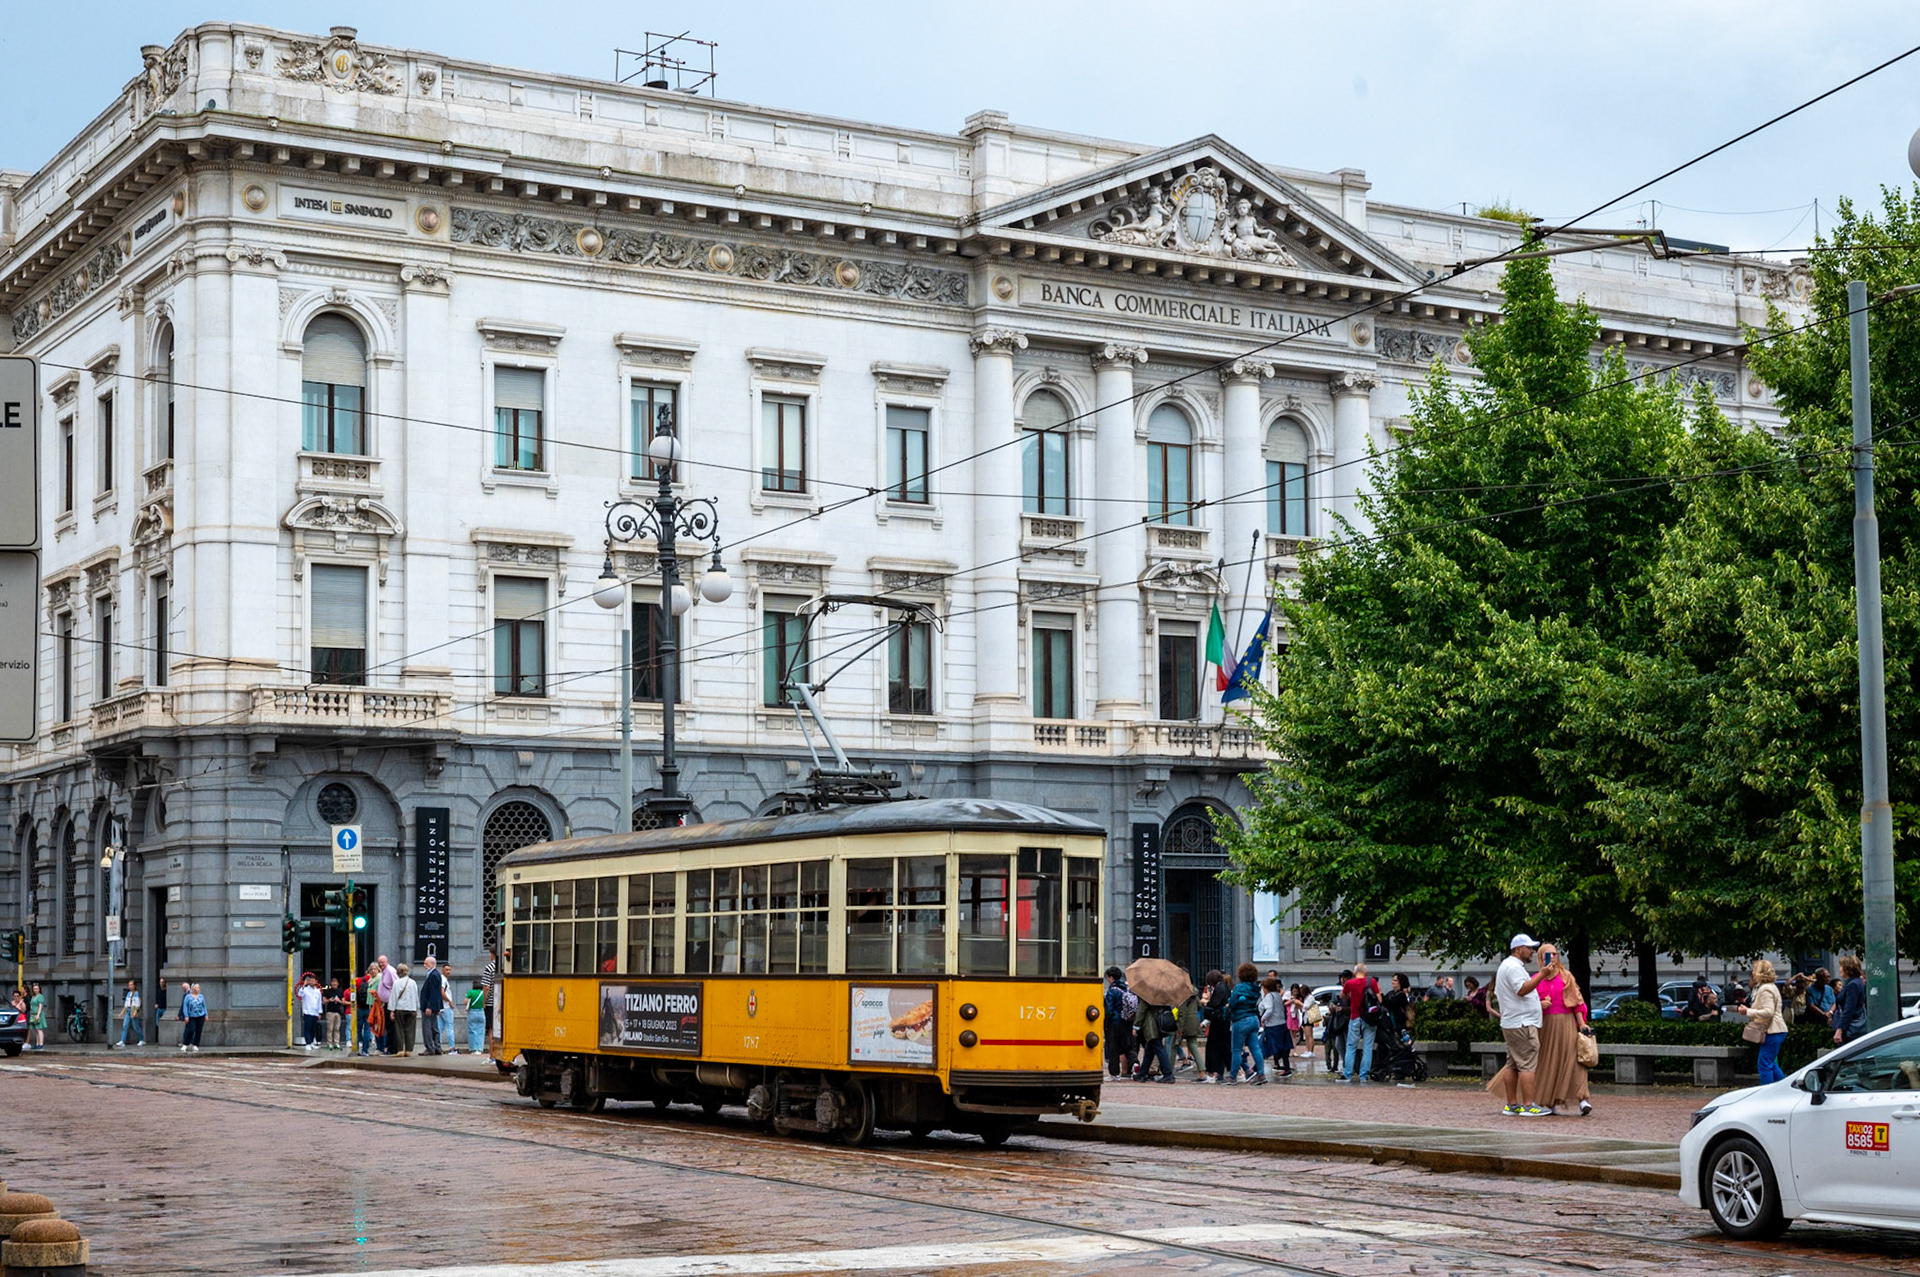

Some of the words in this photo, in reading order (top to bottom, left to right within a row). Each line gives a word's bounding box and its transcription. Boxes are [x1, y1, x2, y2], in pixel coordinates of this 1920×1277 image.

[294, 197, 329, 211] INTESA
[344, 203, 393, 219] SANPAOLO
[1041, 283, 1104, 309] BANCA
[1114, 293, 1241, 326] COMMERCIALE
[1250, 311, 1332, 338] ITALIANA
[0, 401, 21, 428] E
[429, 817, 437, 915] COLLEZIONE
[438, 840, 446, 914] INATTESA
[419, 885, 427, 914] UNA
[625, 993, 663, 1013] TIZIANO
[665, 994, 698, 1014] FERRO
[1020, 1005, 1057, 1020] 1787
[647, 1019, 666, 1030] GIUGNO
[624, 1031, 643, 1042] MILANO
[744, 1036, 759, 1049] 1787
[1848, 1134, 1873, 1148] 8585
